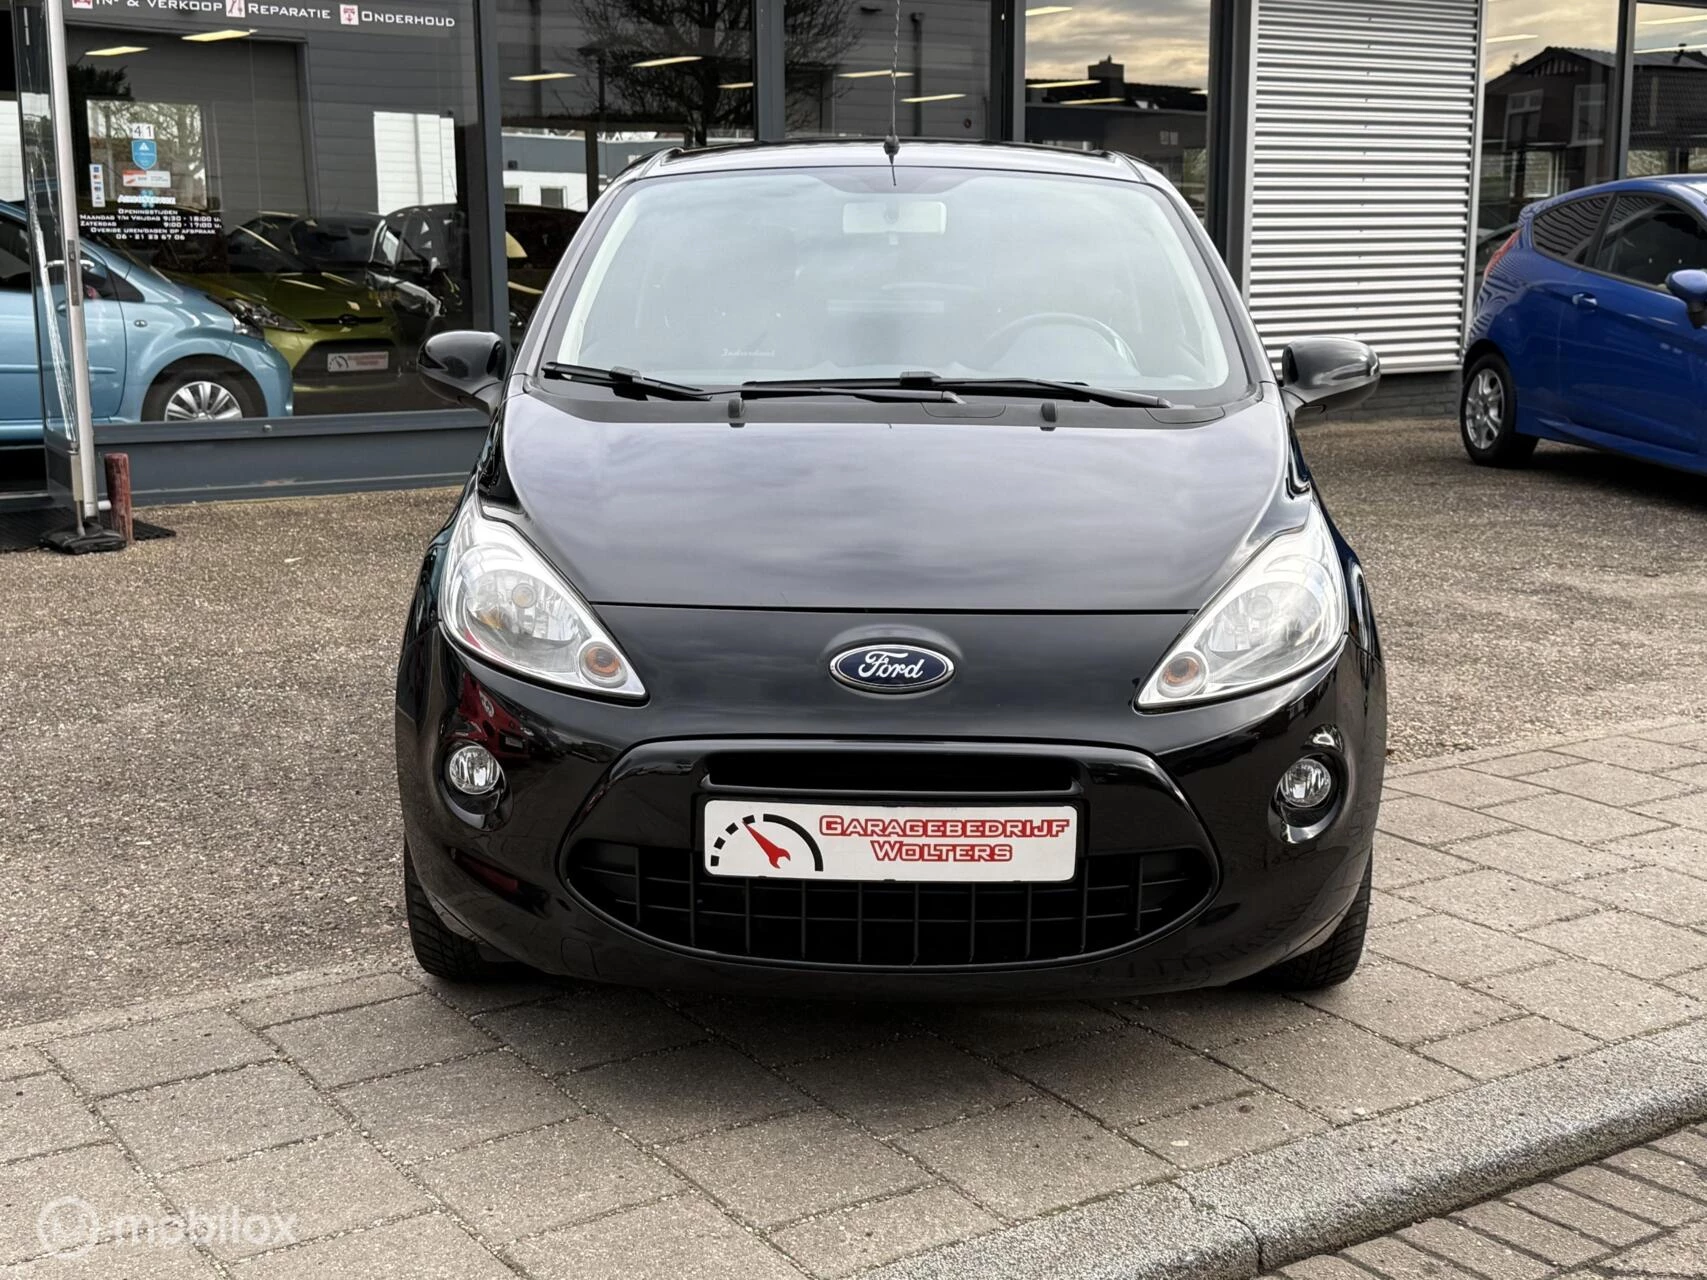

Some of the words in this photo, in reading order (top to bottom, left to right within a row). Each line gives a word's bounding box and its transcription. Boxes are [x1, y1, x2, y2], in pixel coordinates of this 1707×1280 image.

[147, 0, 223, 11] VERKOOP
[248, 4, 331, 19] REPARATIE
[361, 11, 455, 27] ONDERHOUD
[858, 651, 925, 678] Ford
[820, 815, 1070, 838] GARAGEBEDRIJF
[870, 840, 1012, 862] WOLTERS
